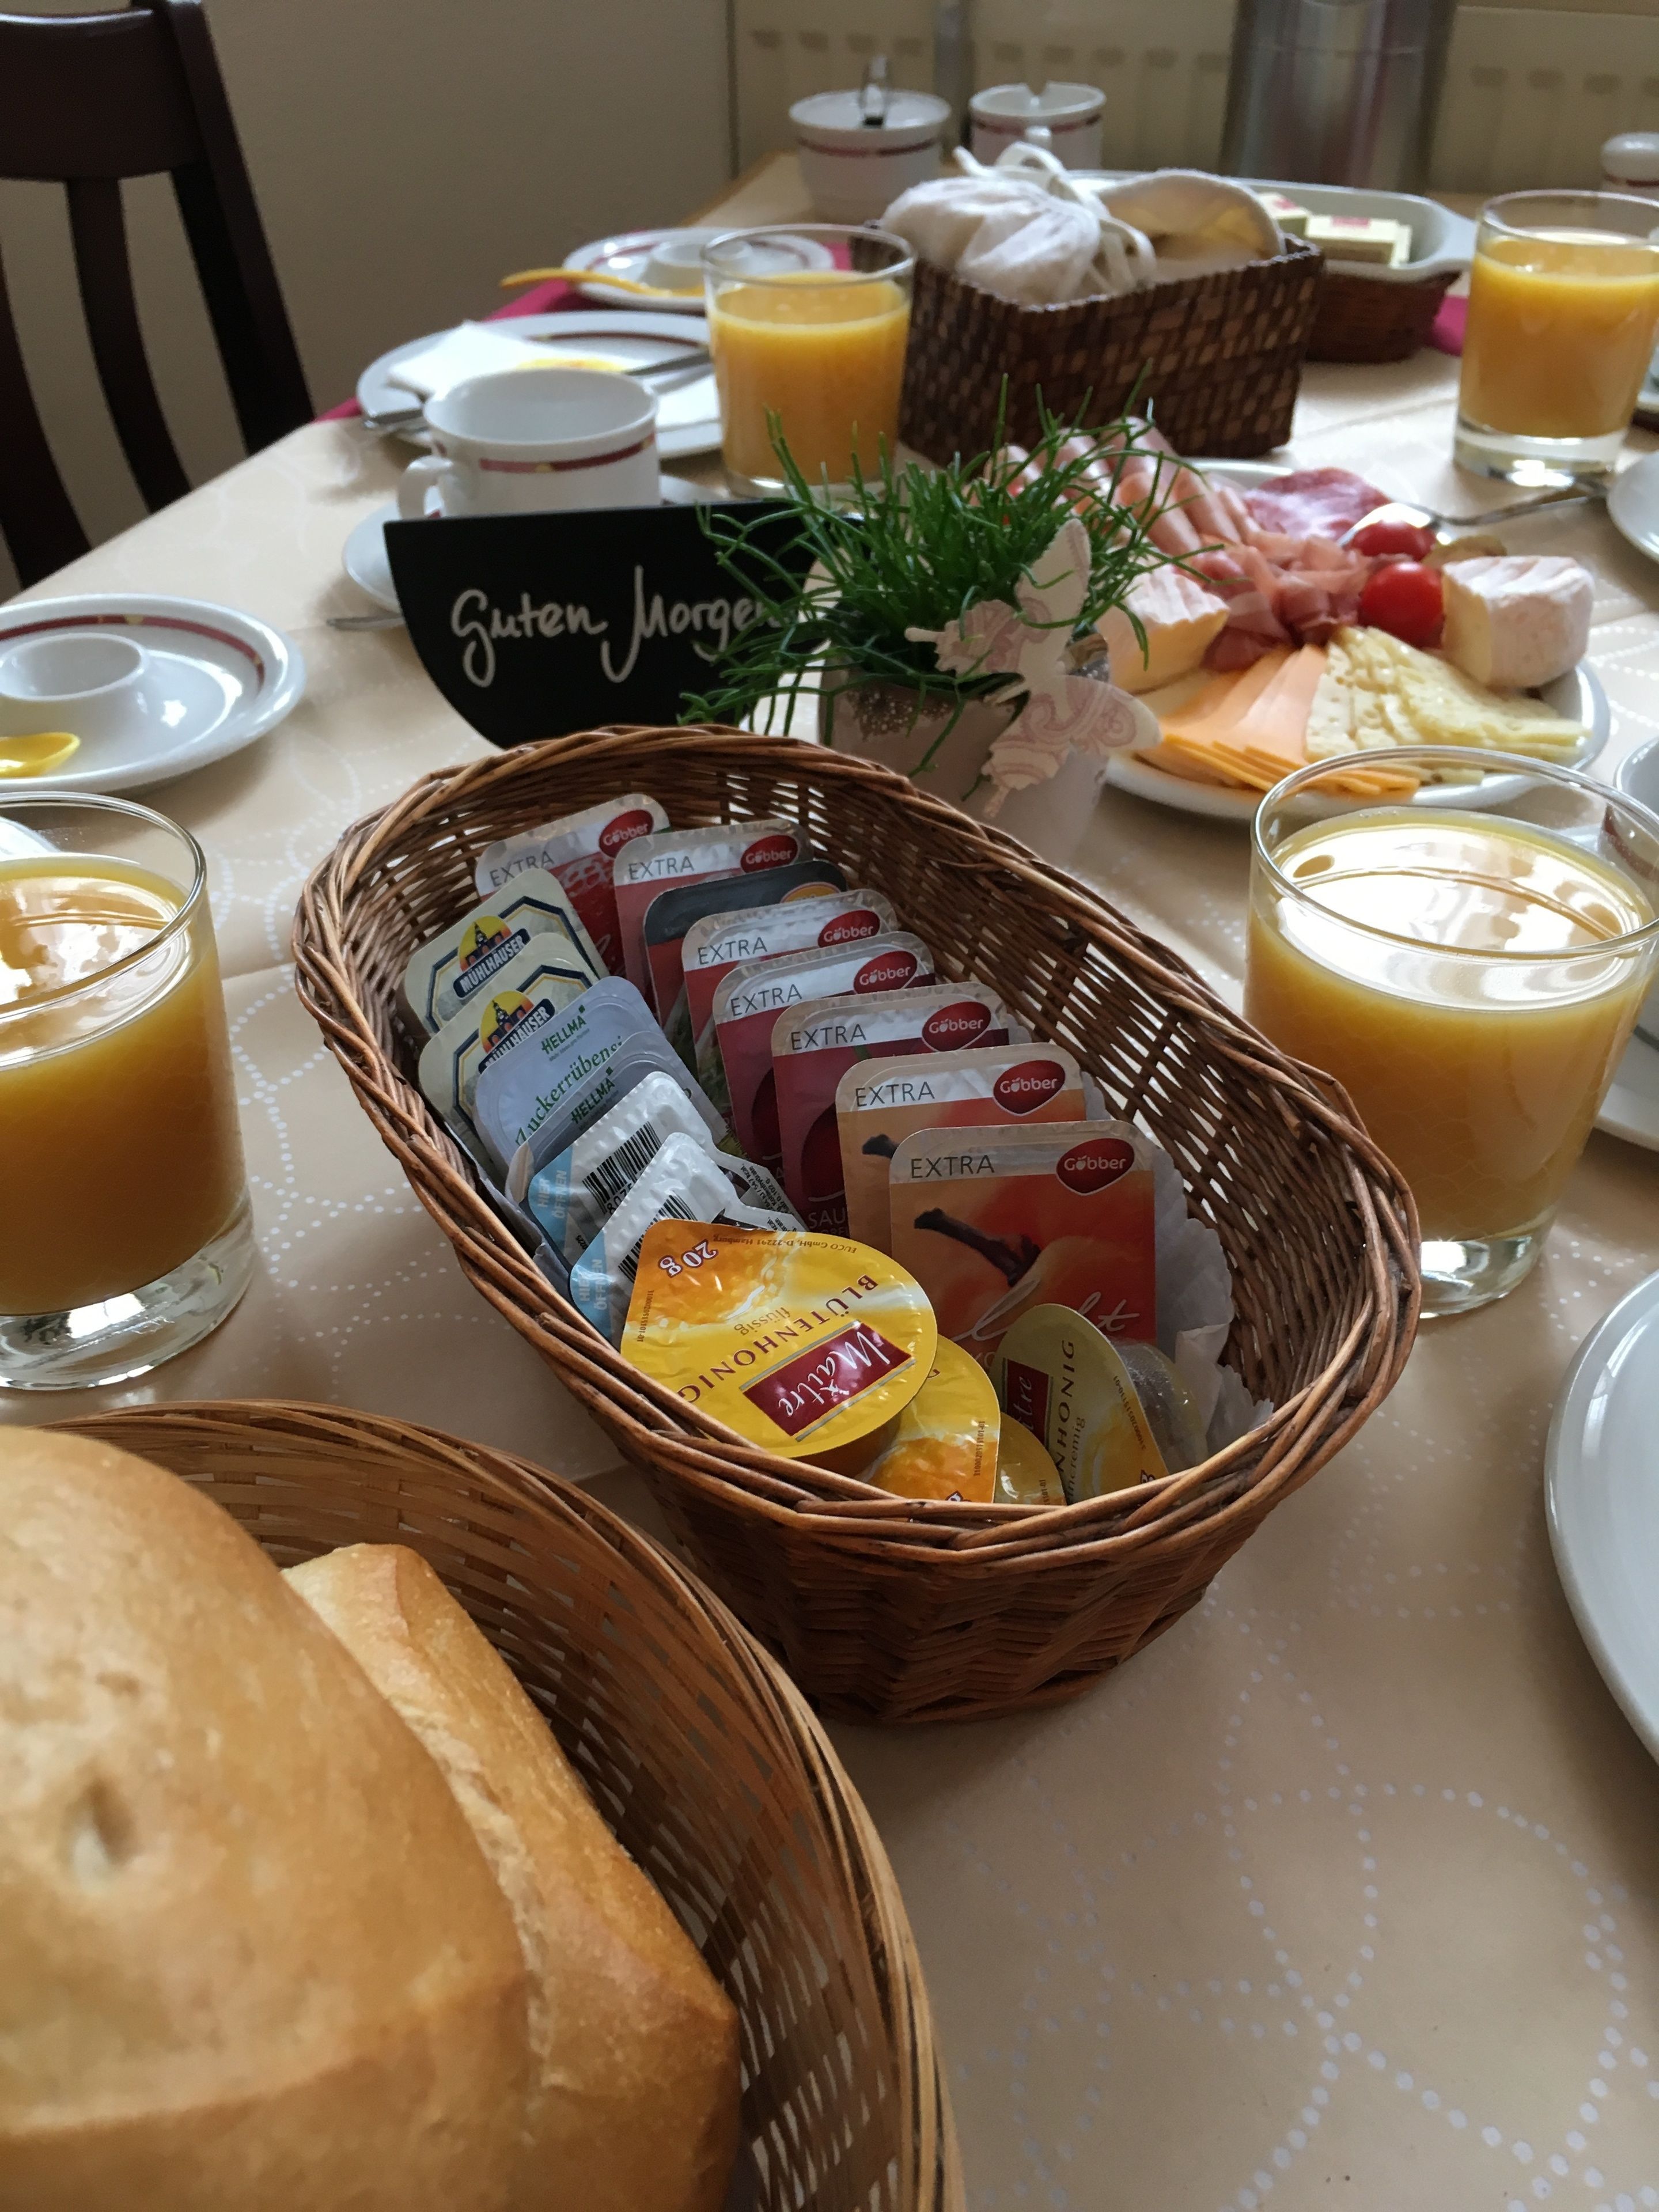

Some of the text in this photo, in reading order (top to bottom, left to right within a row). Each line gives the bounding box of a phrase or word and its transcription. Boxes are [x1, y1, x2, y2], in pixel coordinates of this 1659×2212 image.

[450, 589, 608, 688] Guten
[488, 850, 554, 888] EXTRA
[628, 855, 695, 881] EXTRA
[460, 934, 527, 993] MÜHLHÄUSER
[697, 936, 768, 965] EXTRA
[730, 983, 804, 1017] EXTRA
[540, 1016, 587, 1055] HELLMA
[790, 1024, 867, 1051] EXTRA
[570, 1077, 616, 1124] HELLMA
[855, 1081, 936, 1108] EXTRA
[910, 1154, 995, 1179] EXTRA
[537, 1178, 551, 1208] HIER
[658, 1238, 719, 1278] 20 g
[830, 1242, 858, 1254] EUCO
[733, 1306, 791, 1336] flüssig
[677, 1274, 879, 1404] BLÜTENHONIG
[778, 1330, 891, 1417] Maître
